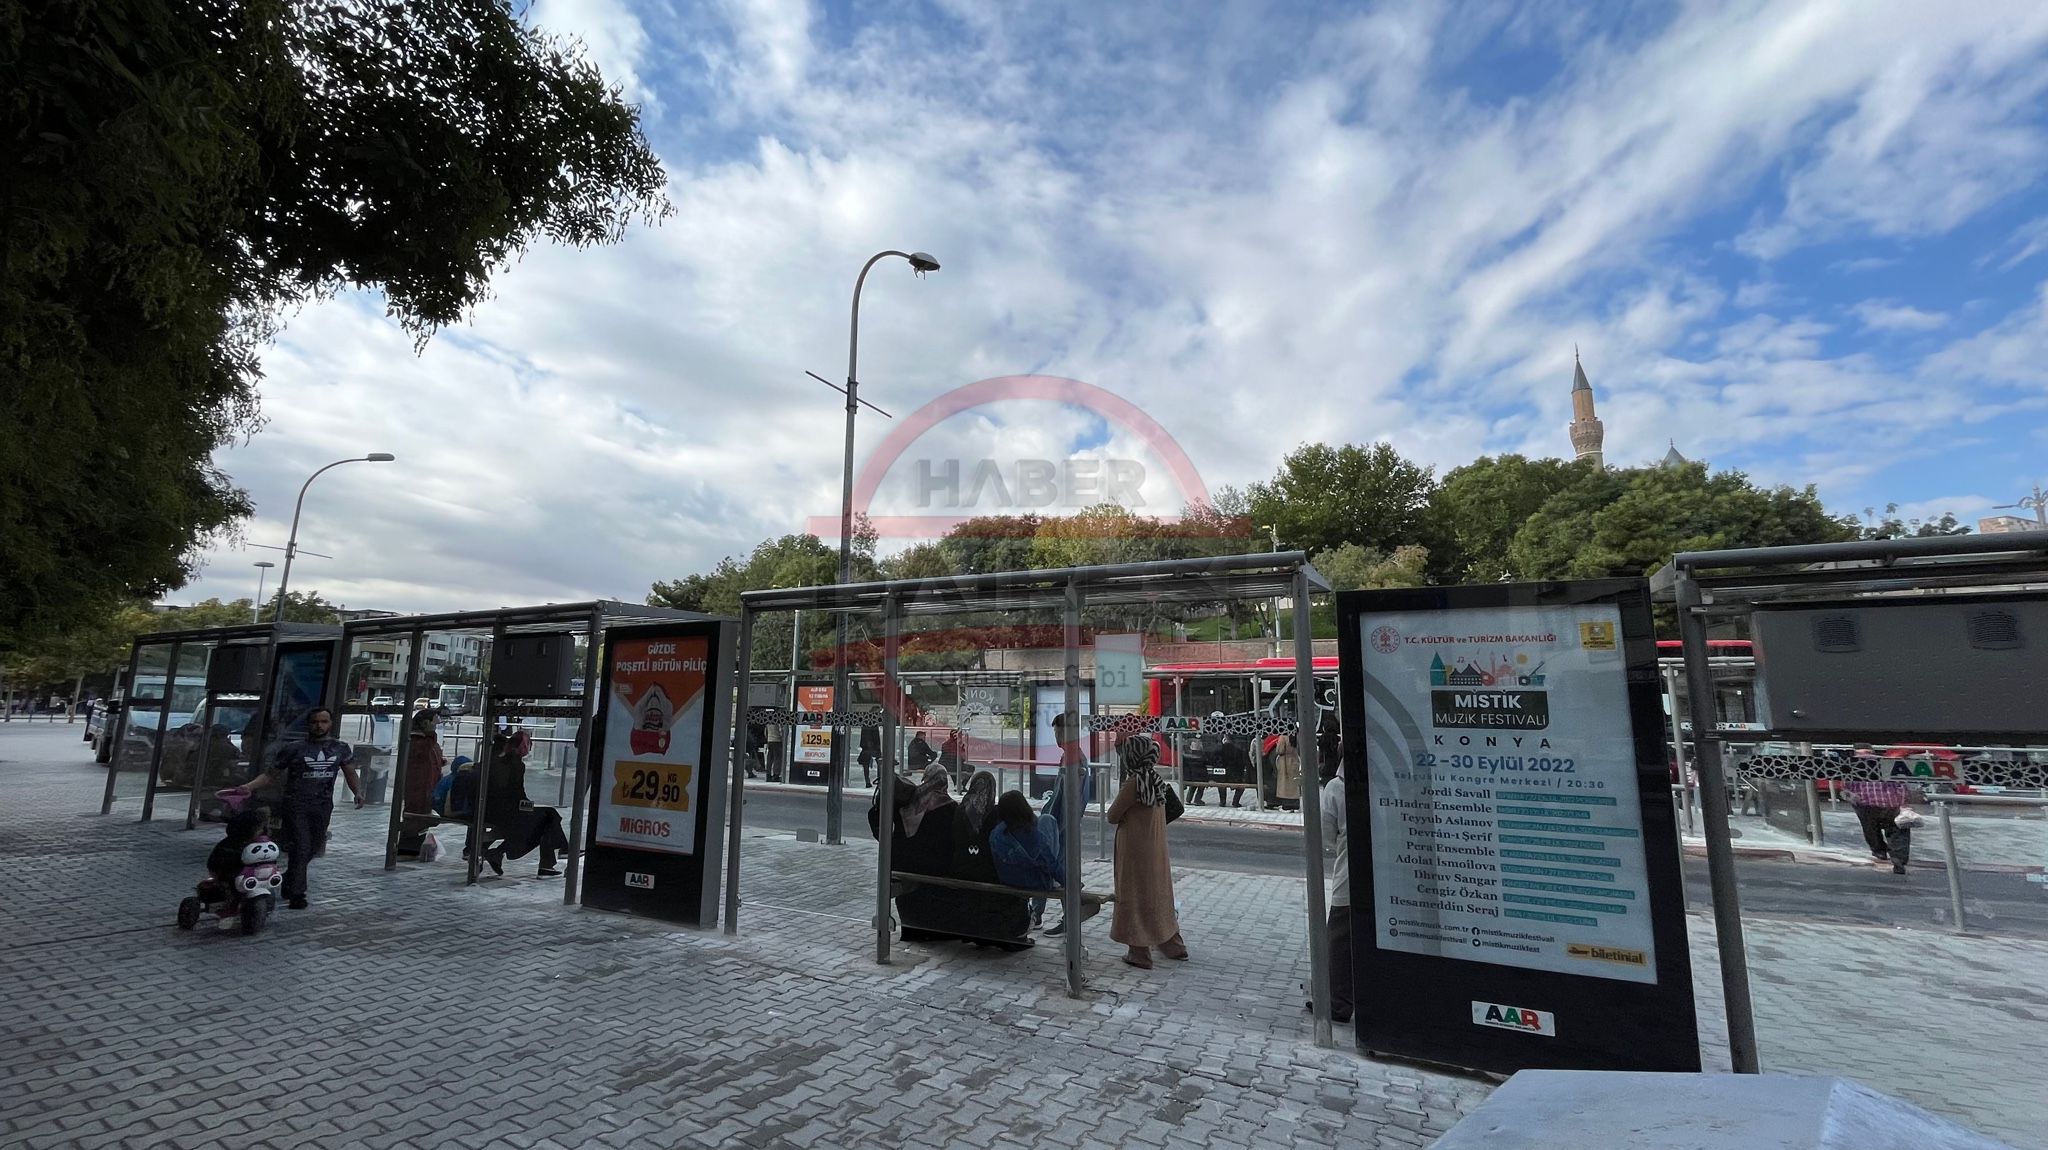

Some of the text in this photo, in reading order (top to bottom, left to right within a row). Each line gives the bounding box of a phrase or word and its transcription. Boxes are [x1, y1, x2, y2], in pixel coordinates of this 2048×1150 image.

[647, 643, 676, 655] GÖZDE
[616, 660, 707, 674] POŞETLİ BÜTÜN PİLİÇ
[1455, 689, 1522, 709] MİSTİK
[802, 713, 824, 723] AAR
[1165, 717, 1200, 730] AAR
[1434, 735, 1552, 749] KONYA
[1478, 755, 1523, 775] Eylül
[1528, 757, 1576, 773] 2022
[1890, 760, 1960, 780] AAR
[667, 773, 678, 782] KG
[1450, 774, 1496, 787] Kongre
[1500, 776, 1551, 787] Merkezi
[1567, 779, 1605, 790] 20:30
[1420, 786, 1452, 799] Jordi
[1454, 787, 1491, 799] Savall
[1379, 798, 1430, 810] El-Hadra
[1433, 800, 1492, 814] Ensemble
[1401, 813, 1493, 828] Teyyub Aslanov
[1407, 841, 1495, 857] Pera Ensemble
[1396, 854, 1433, 867] Adolat
[1435, 856, 1496, 872] İsmoilova
[629, 872, 650, 886] AAR
[1414, 869, 1498, 888] Dhruv Sangar
[1416, 884, 1456, 900] Cengiz
[1458, 886, 1498, 901] Özkan
[1389, 895, 1463, 912] Hesameddin
[1466, 902, 1500, 918] Seraj
[1590, 946, 1643, 965] biletinial
[1485, 1005, 1541, 1032] AAR
